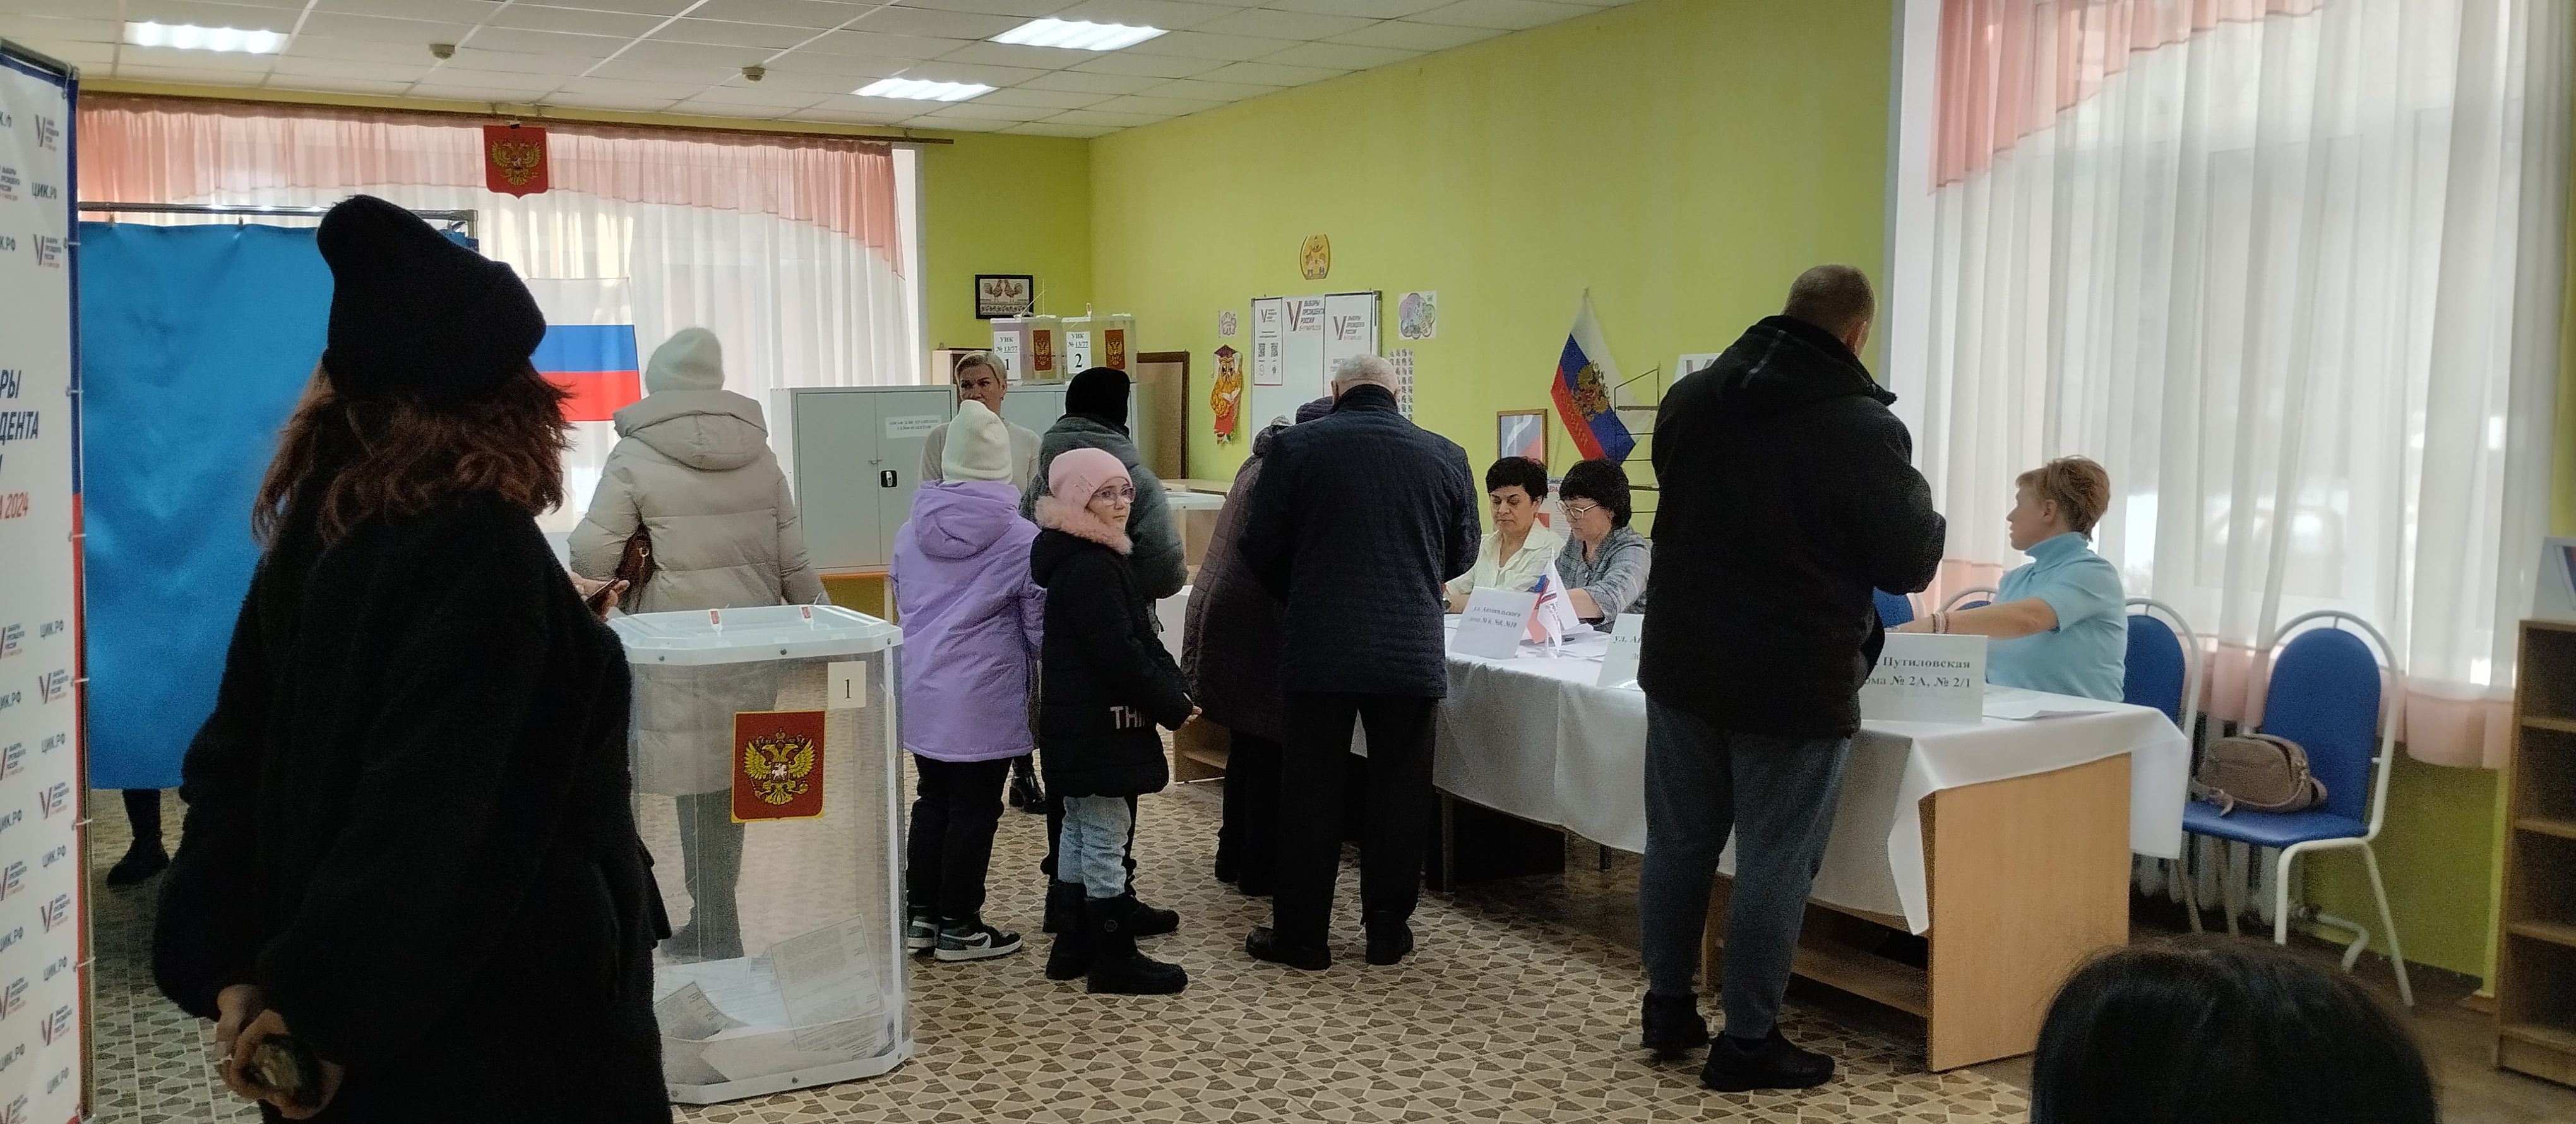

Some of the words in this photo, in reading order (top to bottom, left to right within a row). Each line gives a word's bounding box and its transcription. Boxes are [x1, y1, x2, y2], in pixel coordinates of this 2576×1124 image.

[1005, 358, 1010, 371] 1
[1075, 353, 1083, 368] 2
[0, 369, 21, 398] РЫ
[0, 411, 39, 446] ДЕНТА
[4, 493, 28, 519] 2024
[1883, 656, 1971, 669] Путиловская
[844, 678, 851, 699] 1
[1864, 677, 1887, 685] ома
[1890, 675, 1905, 686] №
[1934, 676, 1949, 688] №
[1953, 678, 1971, 688] 2/1
